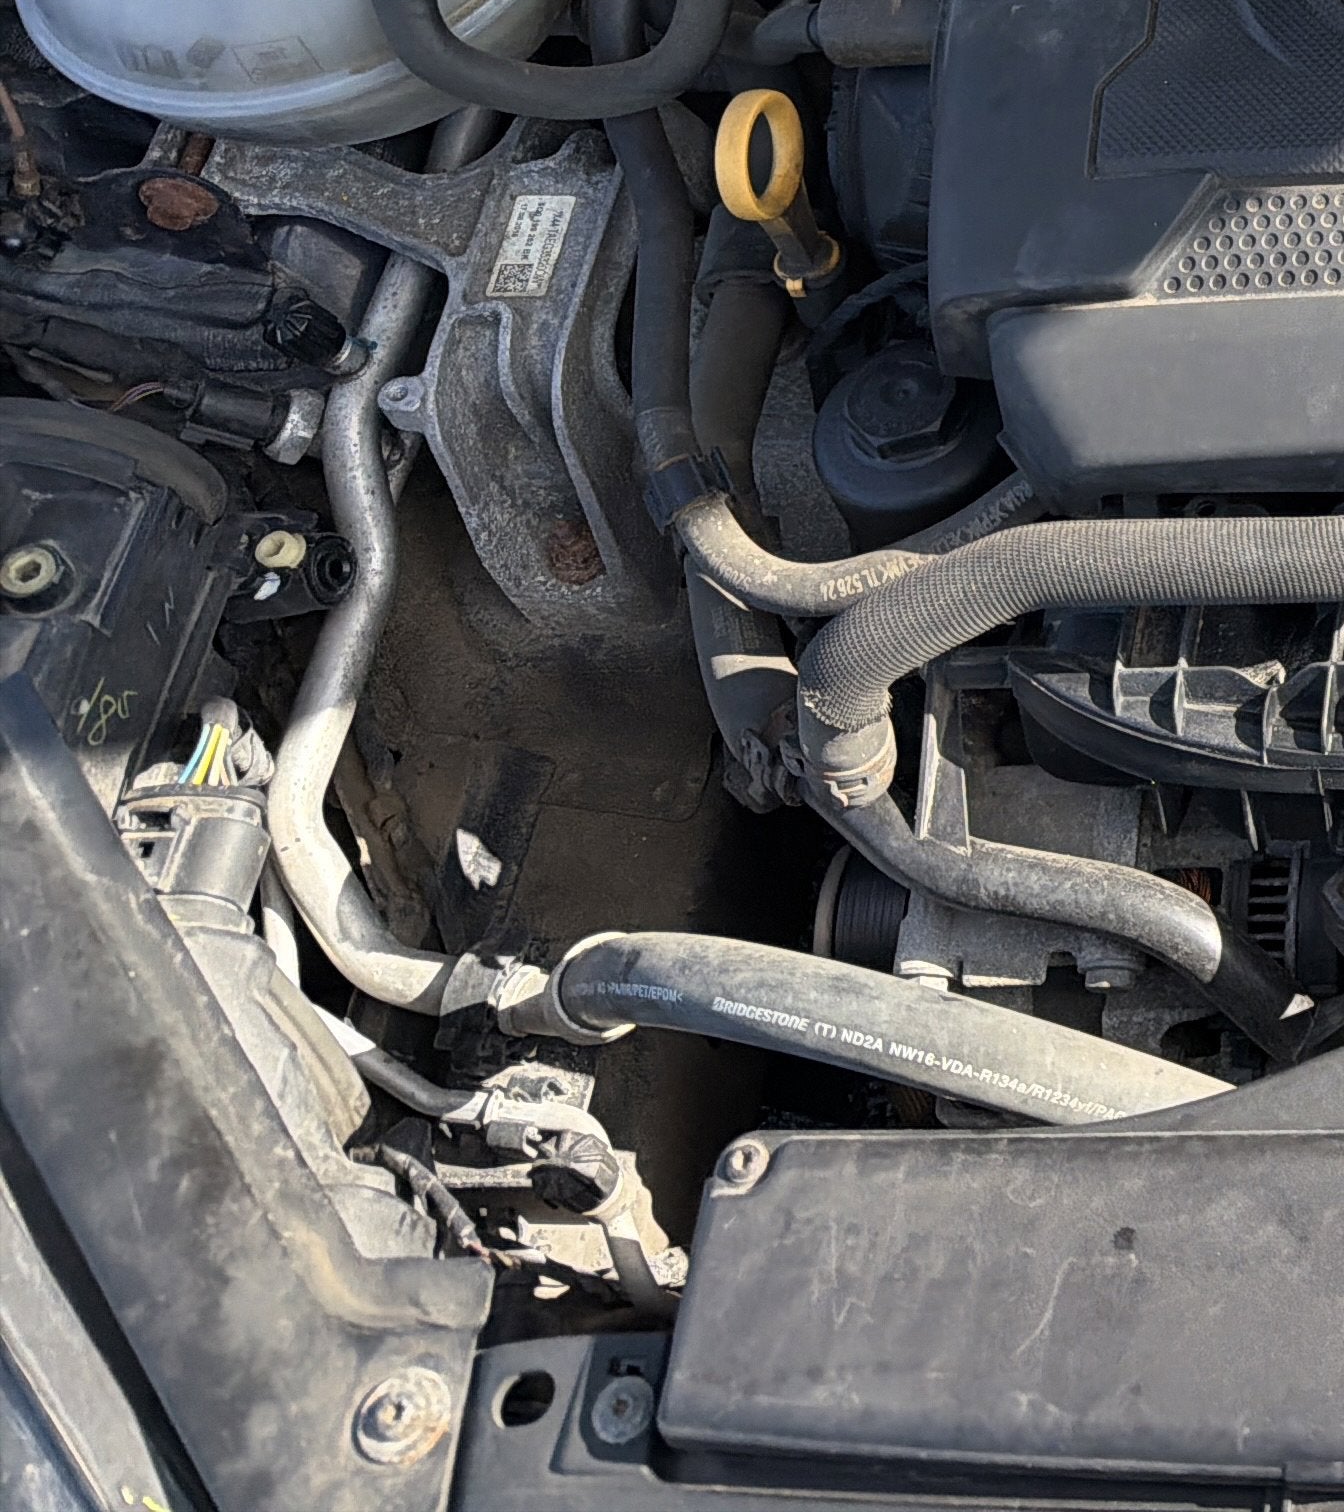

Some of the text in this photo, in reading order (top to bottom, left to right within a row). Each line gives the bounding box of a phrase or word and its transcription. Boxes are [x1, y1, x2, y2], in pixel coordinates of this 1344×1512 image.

[712, 997, 810, 1031] BRIDGESTONE
[815, 1022, 837, 1039] (T)
[841, 1028, 884, 1053] ND2A
